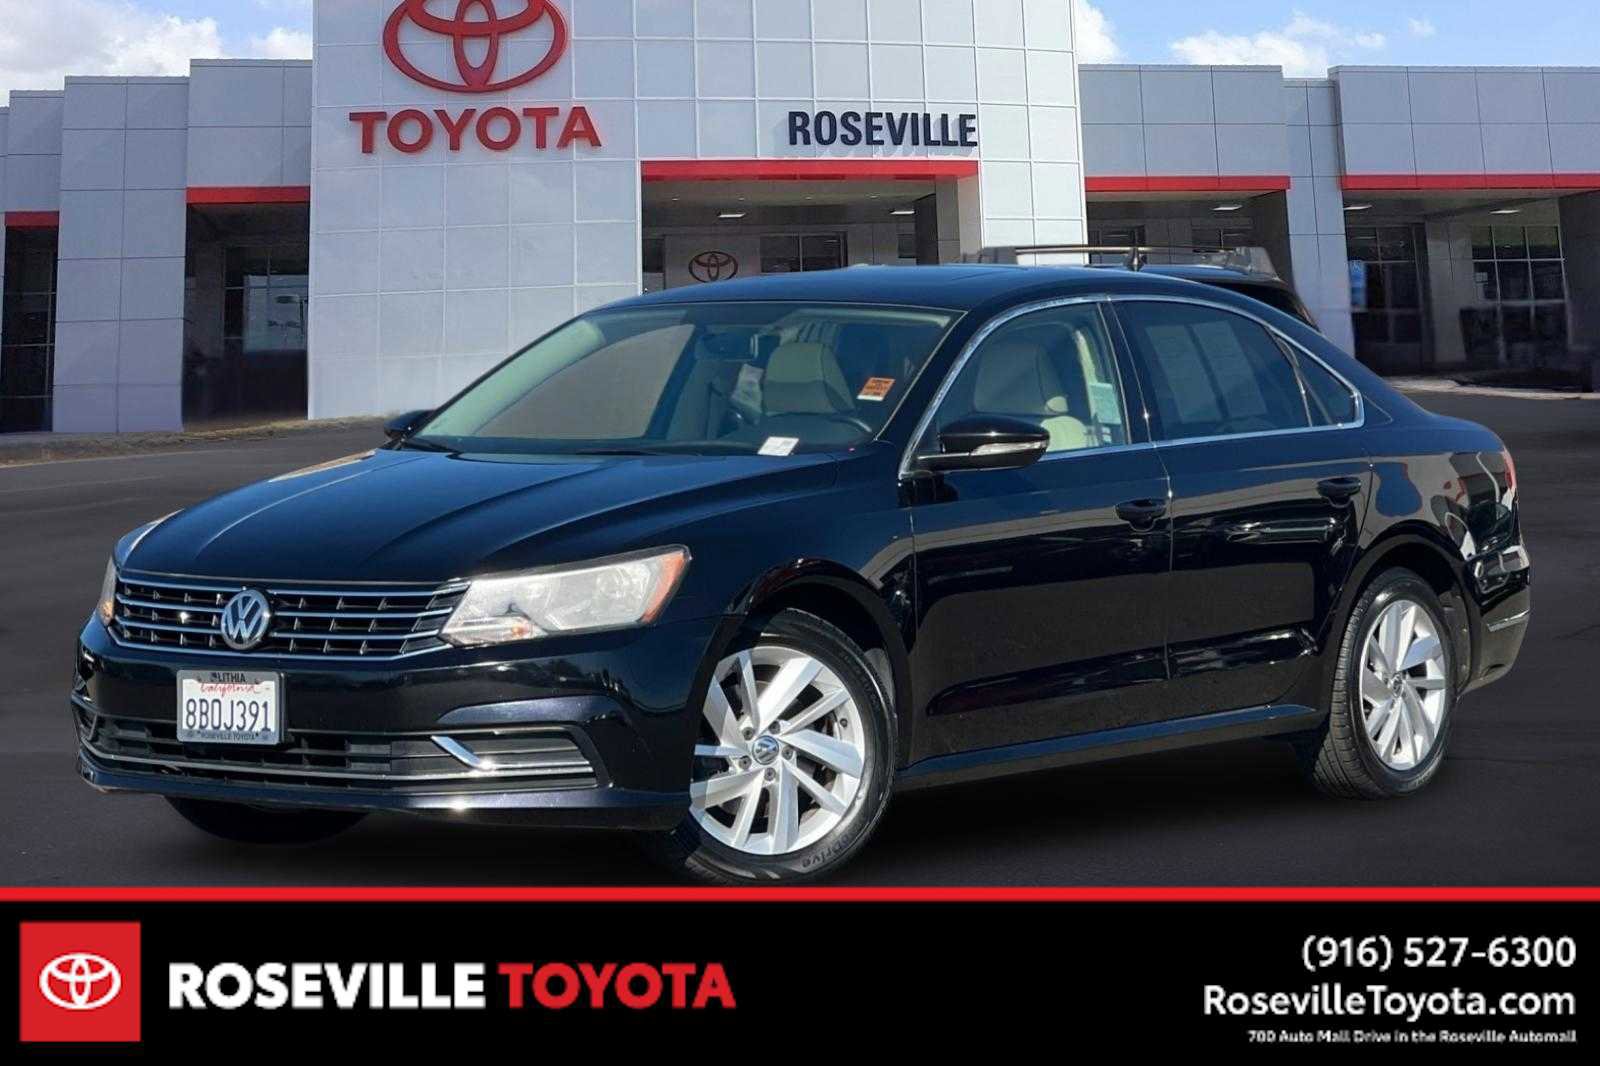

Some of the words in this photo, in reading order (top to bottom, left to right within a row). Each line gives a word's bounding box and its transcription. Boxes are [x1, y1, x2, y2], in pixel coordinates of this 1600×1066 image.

[350, 106, 602, 153] TOYOTA
[789, 111, 978, 147] ROSEVILLE
[217, 672, 247, 683] LITHIA
